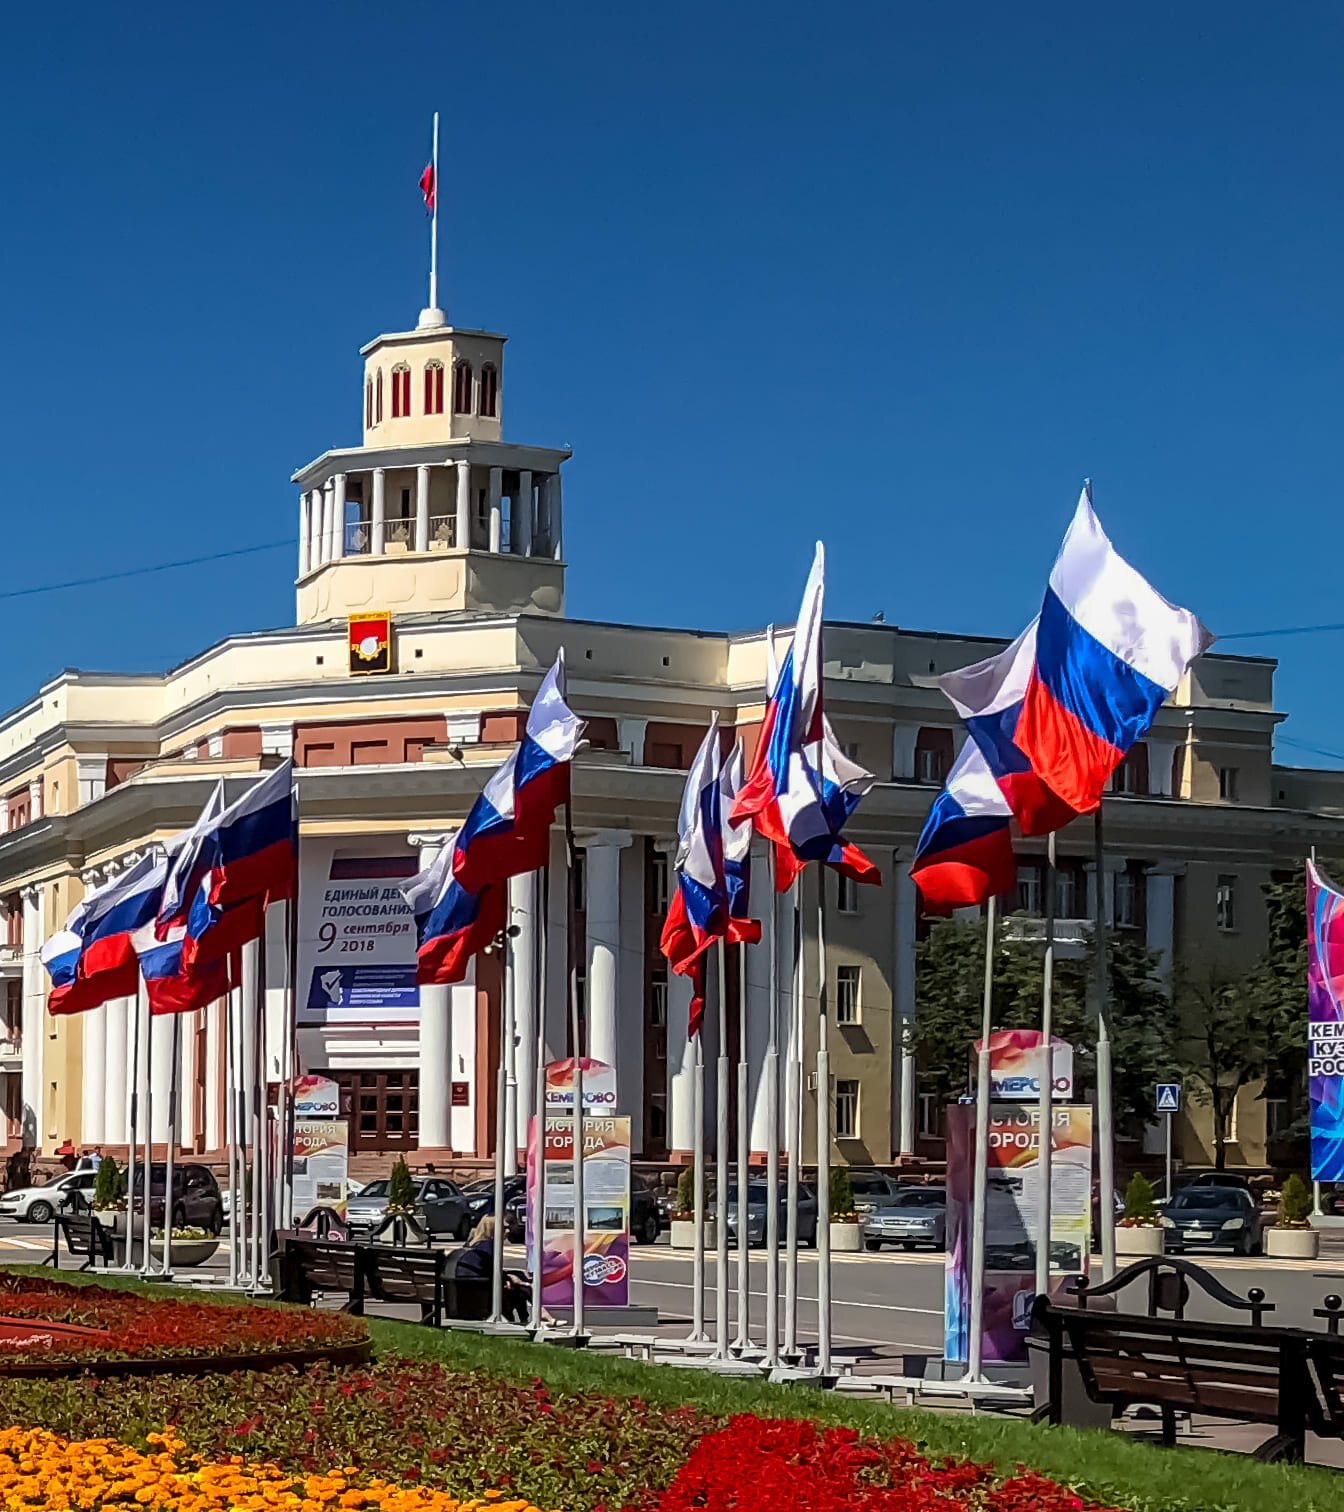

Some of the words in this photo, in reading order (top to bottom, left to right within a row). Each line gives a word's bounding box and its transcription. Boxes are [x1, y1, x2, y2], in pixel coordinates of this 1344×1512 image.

[324, 887, 379, 902] ЕДИНЫЙ
[380, 887, 400, 901] ДЕ
[318, 922, 337, 953] 9
[343, 922, 410, 936] сентября
[340, 940, 375, 952] 2018
[545, 1120, 615, 1132] ИСТРИЯ
[545, 1135, 606, 1150] ГОРДА
